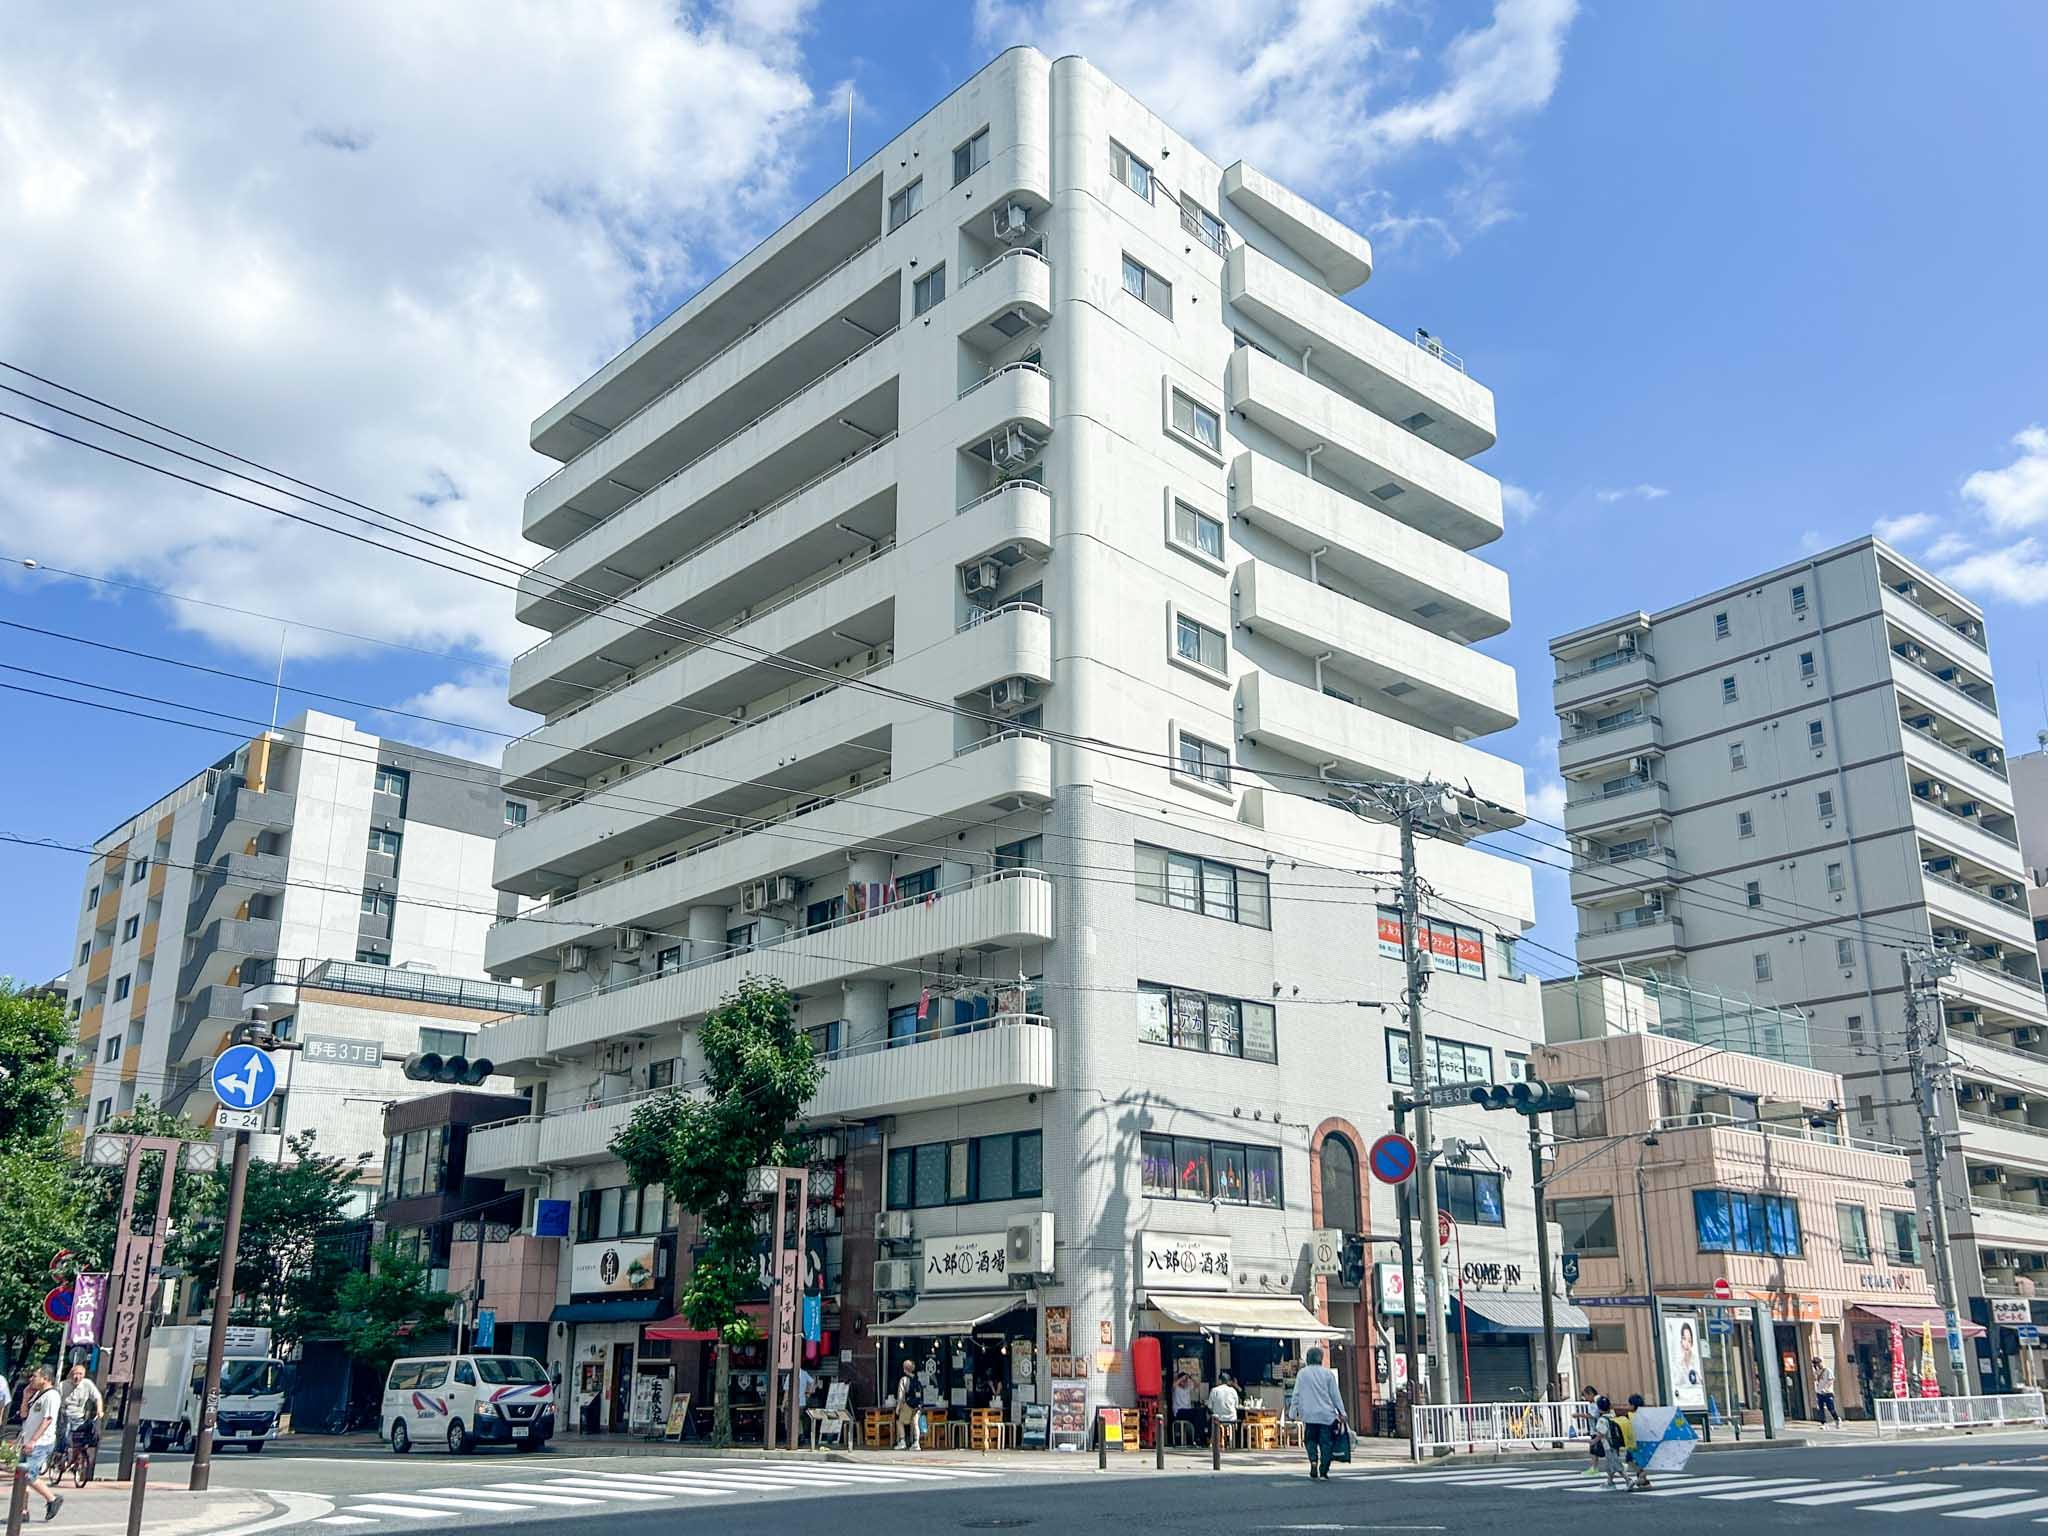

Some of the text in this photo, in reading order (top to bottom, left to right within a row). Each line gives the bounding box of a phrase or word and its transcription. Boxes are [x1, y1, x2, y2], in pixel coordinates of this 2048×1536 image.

[308, 1042, 378, 1062] 野毛3丁目
[1433, 1087, 1471, 1104] 野毛3丁
[1463, 1262, 1502, 1282] COME
